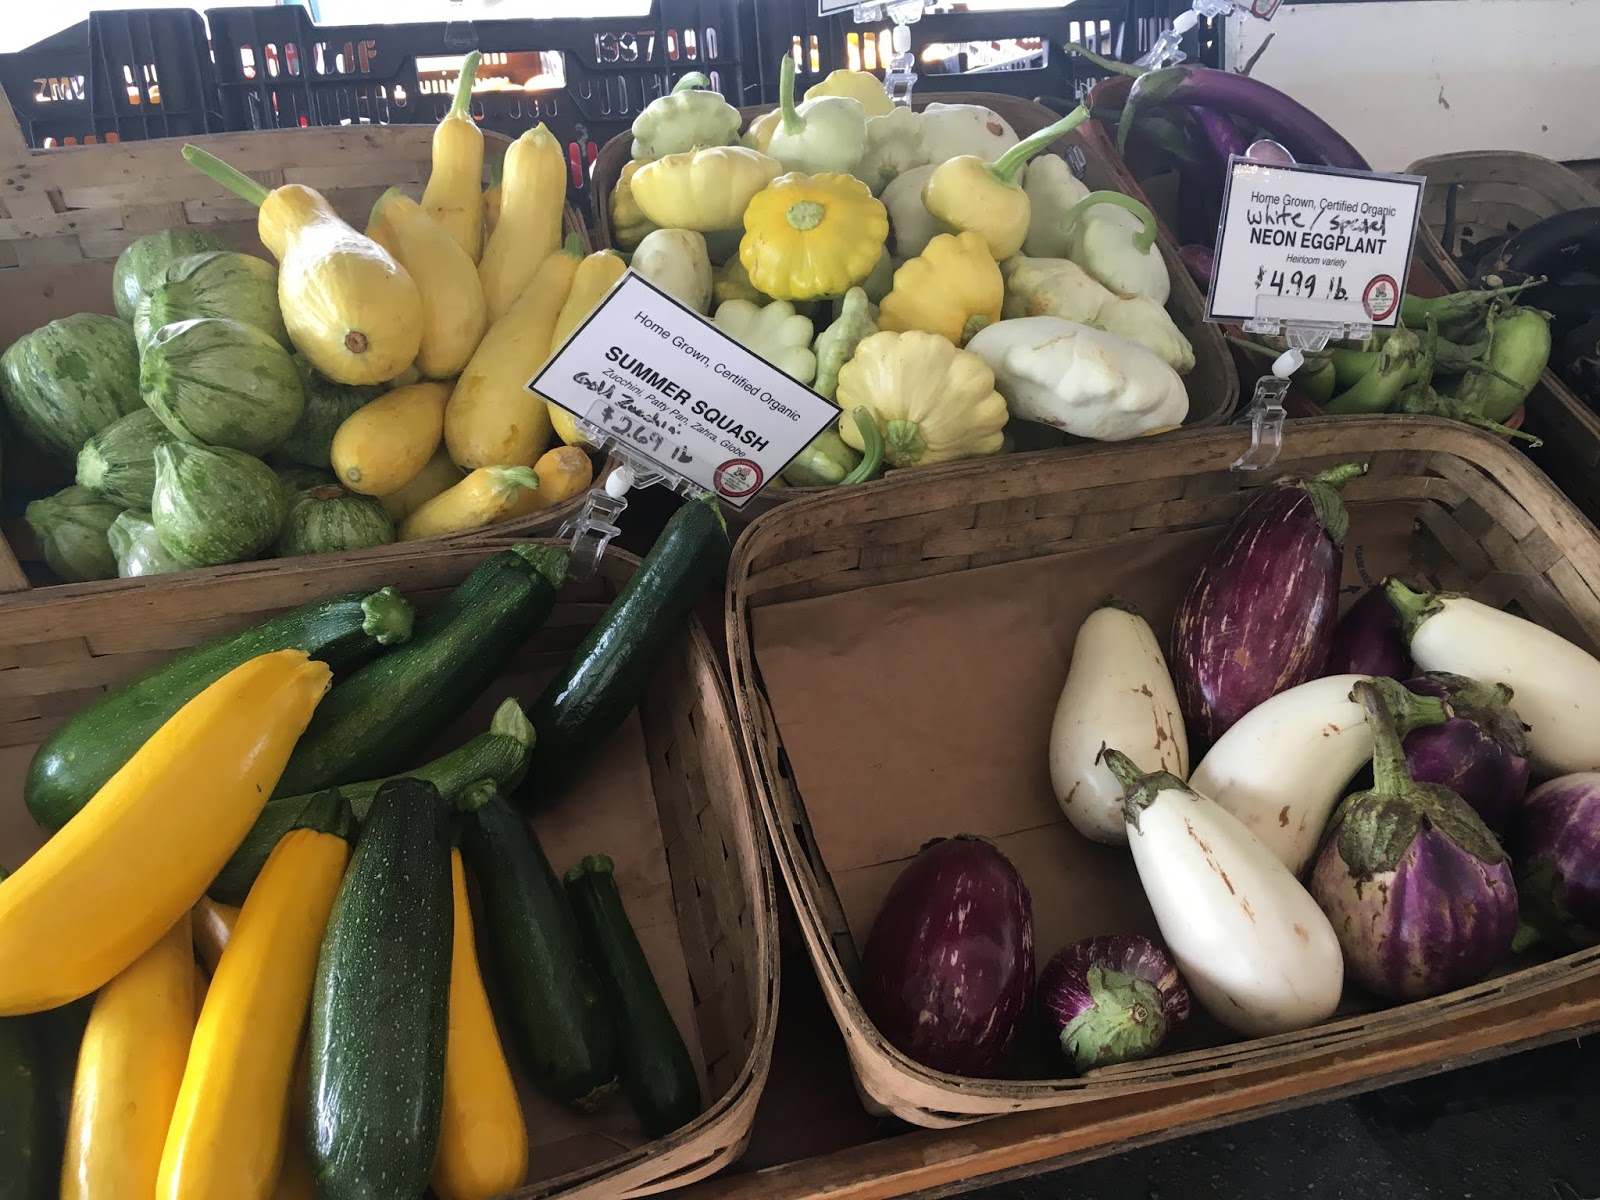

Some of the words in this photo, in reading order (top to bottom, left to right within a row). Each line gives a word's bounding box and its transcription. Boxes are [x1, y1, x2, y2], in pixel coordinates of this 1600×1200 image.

[1251, 190, 1281, 205] Home
[1282, 193, 1316, 210] Grown,
[1319, 198, 1359, 213] Certified
[1360, 202, 1397, 218] Organic
[1250, 227, 1297, 248] NEON
[1300, 232, 1387, 255] EGGPLANT
[1285, 253, 1320, 266] Heirloom
[1321, 256, 1348, 269] variety
[634, 310, 671, 341] Home
[671, 335, 711, 368] Grown,
[713, 362, 760, 397] Certified
[759, 391, 802, 423] Organic
[601, 367, 643, 398] Zucchini,
[645, 392, 671, 418] Patty
[668, 407, 690, 426] Pan,
[690, 421, 718, 444] Zahra,
[719, 439, 747, 459] Globe
[604, 345, 693, 407] SUMMER
[690, 399, 771, 453] SQUASH
